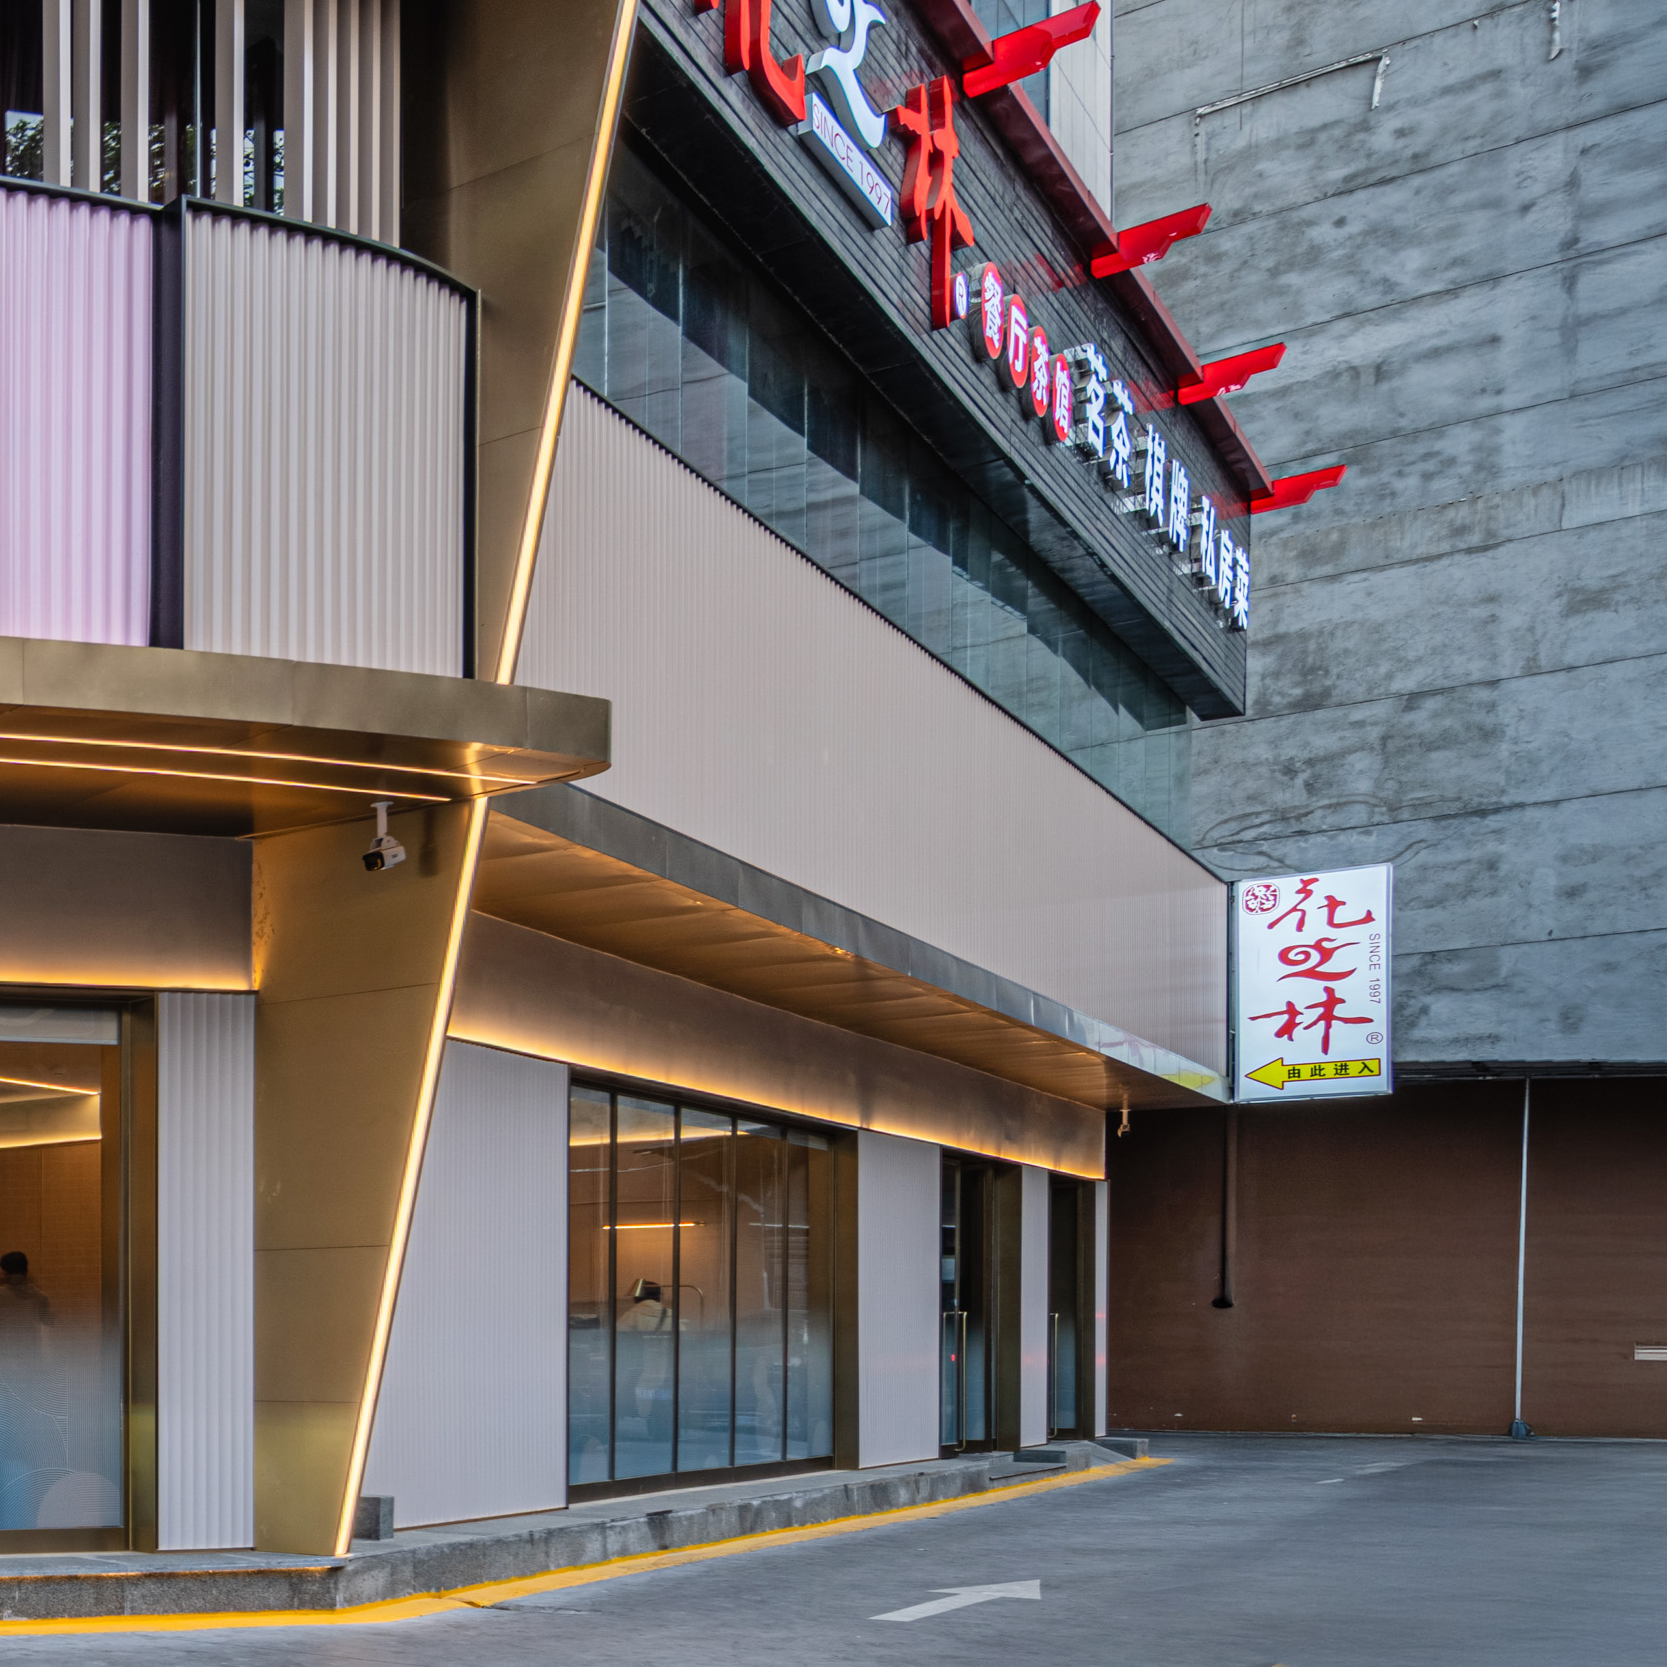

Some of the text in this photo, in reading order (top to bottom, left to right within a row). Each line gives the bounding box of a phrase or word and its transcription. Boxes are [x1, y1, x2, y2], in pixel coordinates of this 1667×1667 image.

[812, 103, 892, 215] SINCE 1997
[983, 270, 1071, 433] 餐厅茶馆
[1085, 342, 1251, 630] 茗茶 棋牌 私房菜
[1368, 933, 1381, 1005] SINCE 1997
[1287, 1060, 1375, 1079] 由此进入
